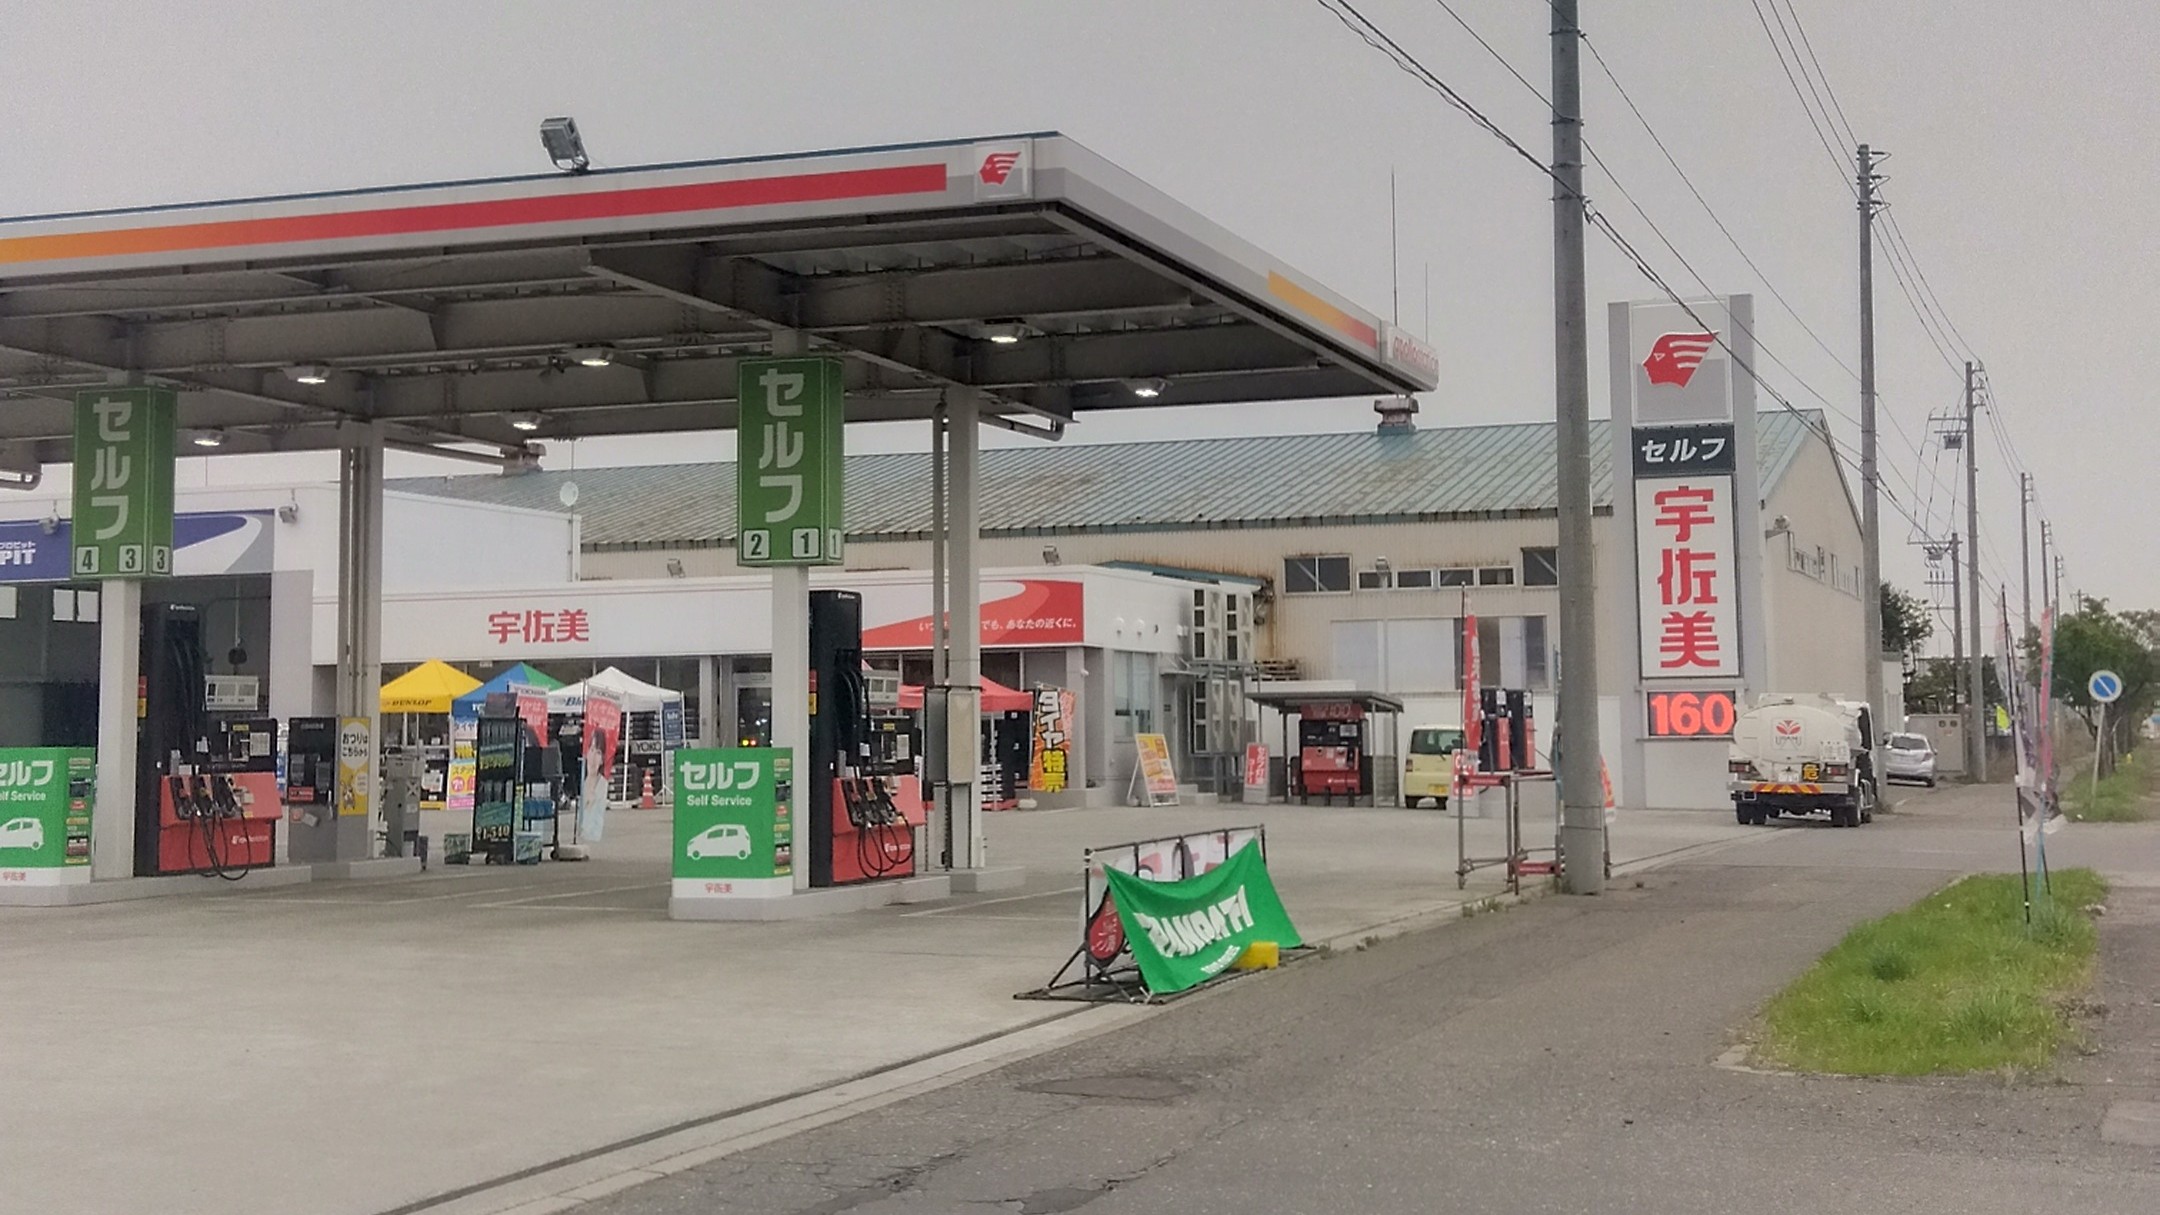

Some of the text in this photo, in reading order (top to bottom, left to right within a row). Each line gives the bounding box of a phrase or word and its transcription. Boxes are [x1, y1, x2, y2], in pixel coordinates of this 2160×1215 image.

[758, 368, 805, 523] セルフ
[1641, 437, 1726, 463] セルフ
[90, 396, 132, 540] セルフ
[750, 534, 763, 556] 2
[800, 533, 810, 555] 1
[831, 534, 838, 555] 1
[82, 550, 93, 571] 4
[126, 549, 136, 570] 3
[156, 549, 165, 570] 3
[1654, 485, 1721, 668] 宇佐美
[488, 608, 589, 643] 宇佐美
[392, 699, 432, 707] DUNLOP
[1650, 692, 1736, 735] 160
[680, 761, 760, 790] セルフ
[11, 791, 46, 801] Service
[687, 794, 752, 806] Self Service
